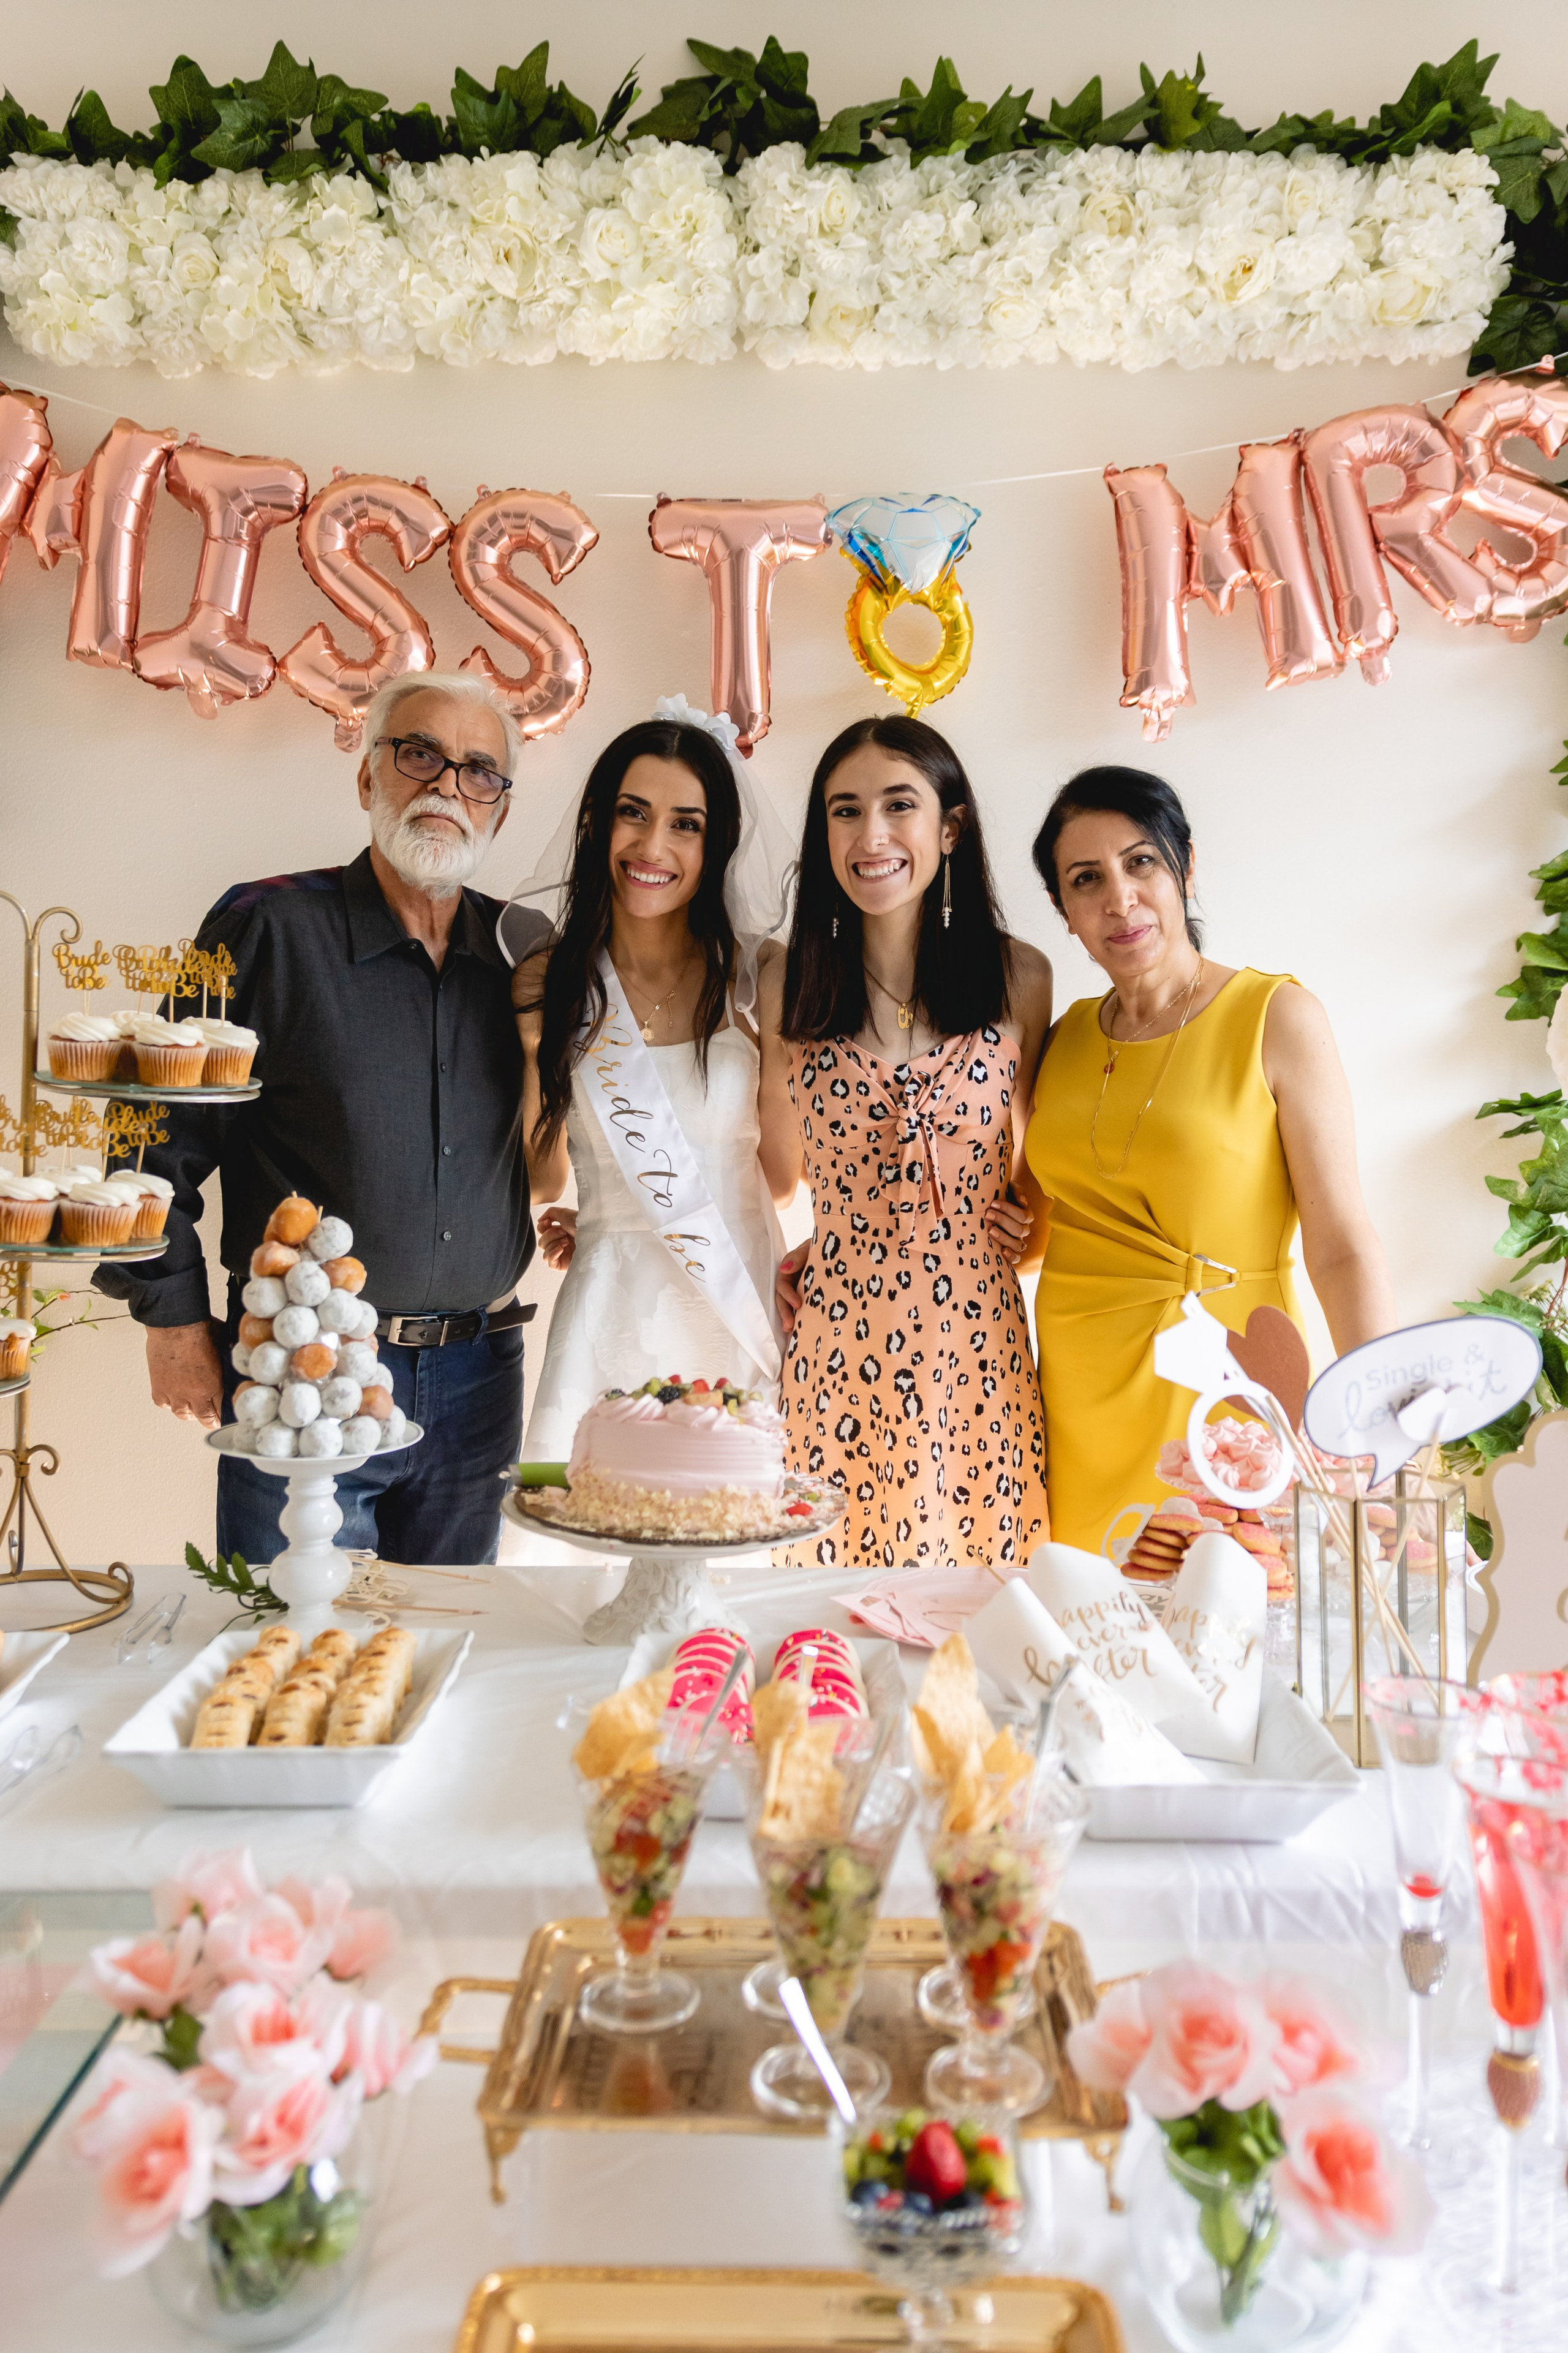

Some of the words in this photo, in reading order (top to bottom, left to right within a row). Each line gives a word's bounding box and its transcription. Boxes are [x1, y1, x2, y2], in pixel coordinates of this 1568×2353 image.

[1104, 366, 1568, 709] MRS
[53, 940, 111, 969] Bride
[573, 1003, 654, 1153] Bride
[638, 1149, 678, 1207] to
[664, 1234, 710, 1282] be
[1464, 1343, 1485, 1365] &
[1055, 1591, 1152, 1633] appily
